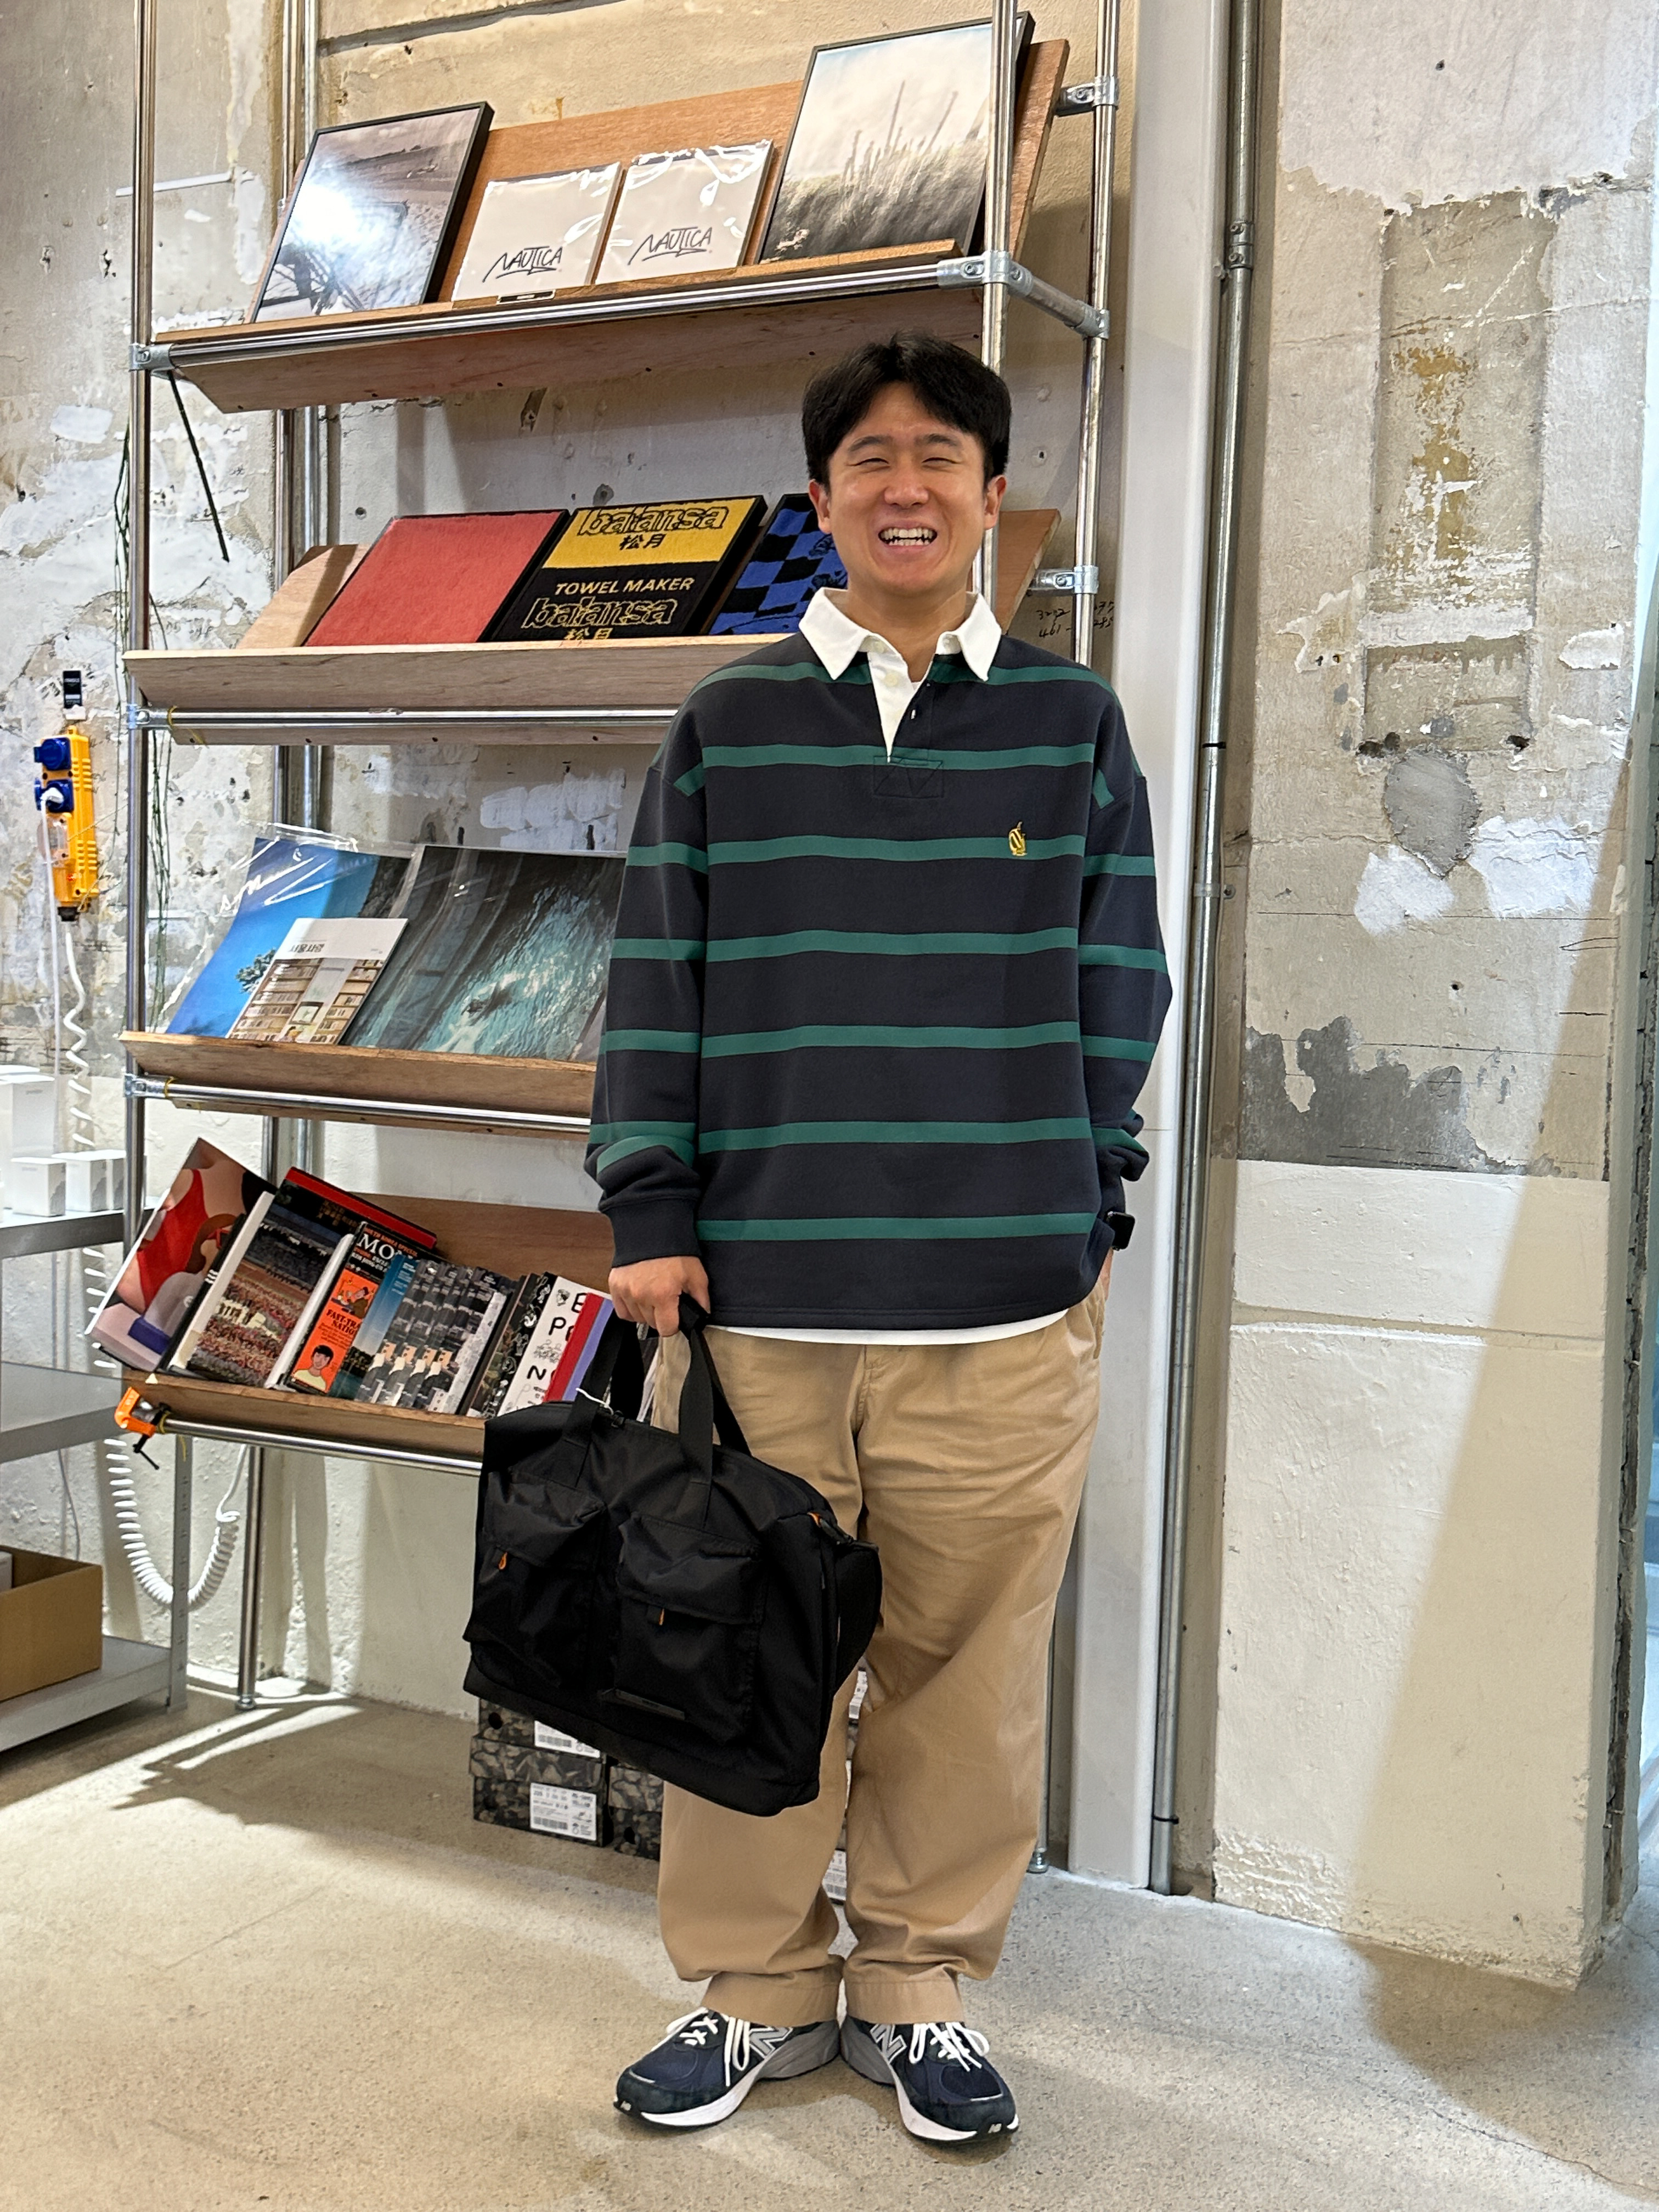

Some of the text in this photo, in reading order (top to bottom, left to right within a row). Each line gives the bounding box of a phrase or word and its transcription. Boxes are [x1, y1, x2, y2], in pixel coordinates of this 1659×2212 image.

[628, 226, 713, 266] NAUTICA
[483, 245, 563, 283] NAUTICA
[619, 533, 667, 550] 松月
[555, 577, 695, 595] TOWEL MAKER
[356, 1233, 409, 1260] MO
